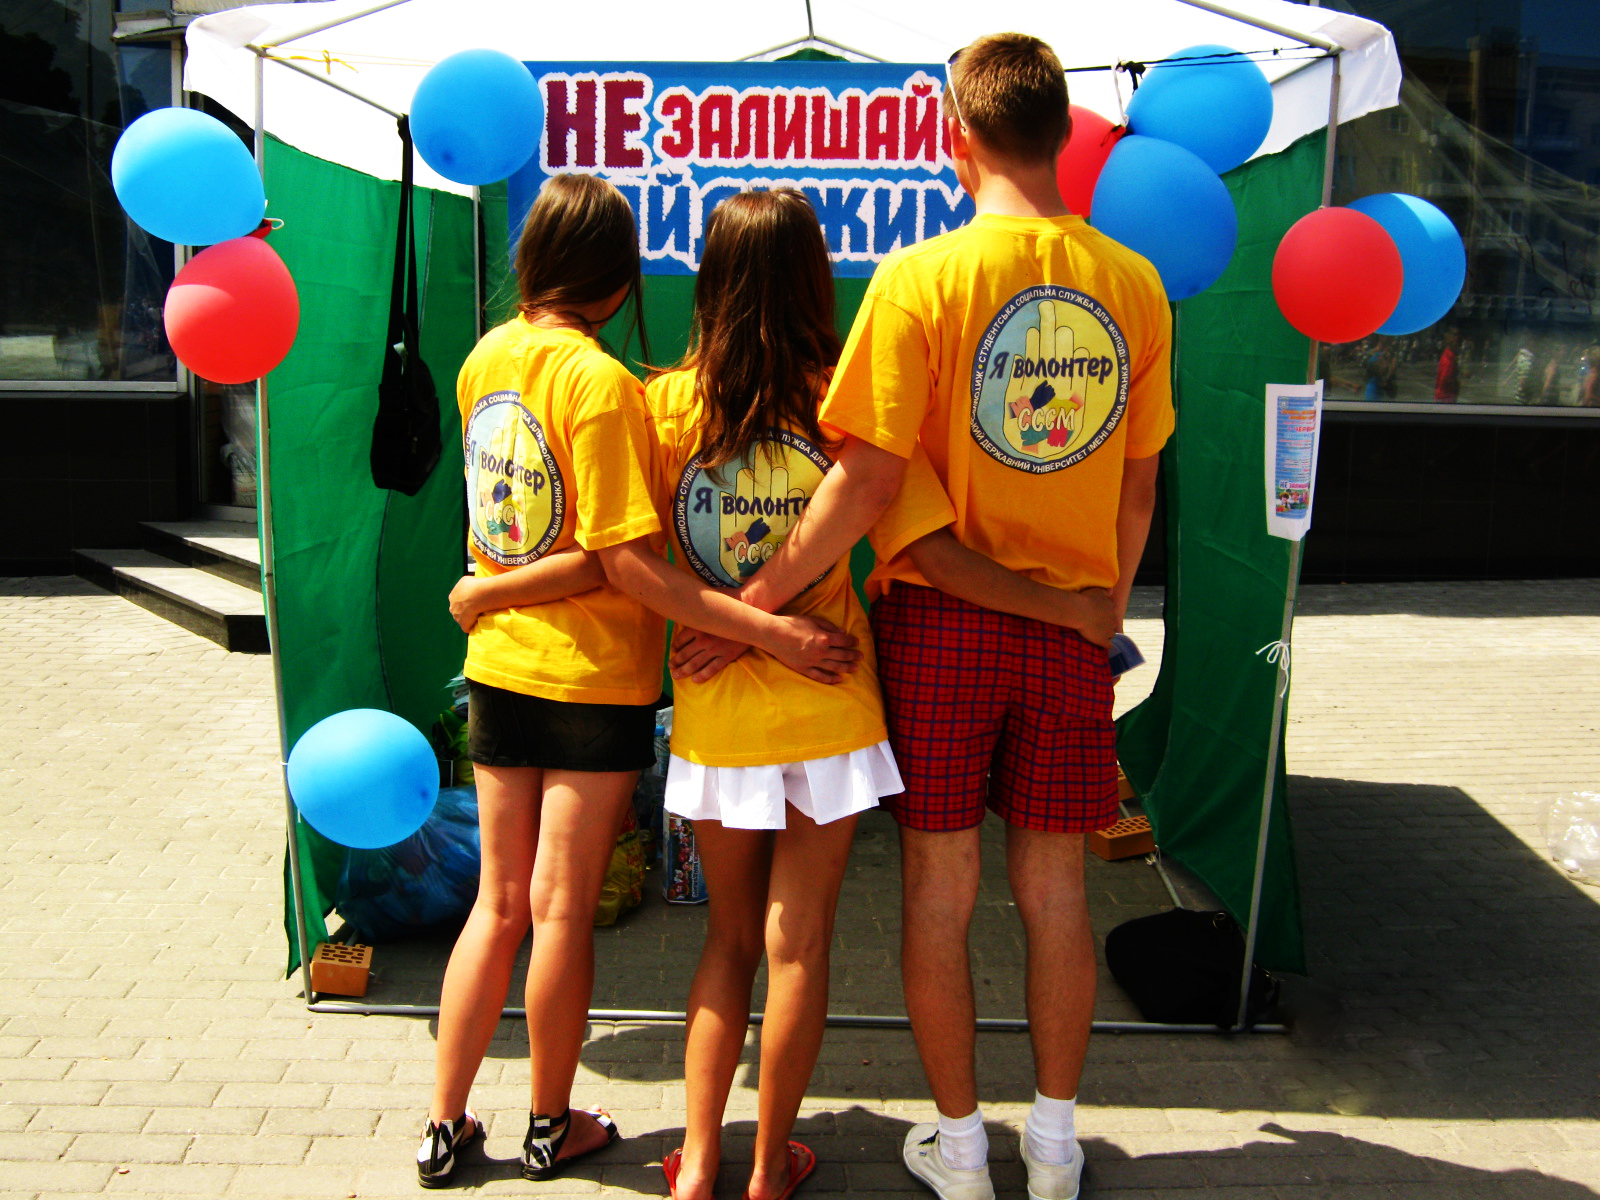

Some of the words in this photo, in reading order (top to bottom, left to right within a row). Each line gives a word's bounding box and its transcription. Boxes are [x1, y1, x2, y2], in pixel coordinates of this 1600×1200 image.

[546, 80, 644, 167] НЕ
[661, 79, 953, 162] ЗАЛИШАЙ
[978, 304, 1017, 363] СТУДЕНТСЬКА
[1058, 290, 1095, 311] СЛУЖБА
[1094, 307, 1110, 325] ДЛЯ
[1107, 324, 1126, 358] МОЛОДІ
[988, 352, 1010, 380] Я
[980, 439, 1031, 471] ДЕРЖАВНИЙ
[1032, 450, 1088, 474] УНІВЕРСИТЕТ
[1087, 429, 1108, 452] ІМЕНІ
[1107, 405, 1125, 432] ІВАНА
[1119, 363, 1129, 403] ФРАНКА
[1017, 407, 1076, 432] СССМ
[529, 422, 543, 441] ДЛЯ
[539, 440, 557, 474] МОЛОДІ
[810, 451, 829, 468] ДЛЯ
[554, 480, 563, 515] ФРАНКА
[693, 487, 714, 514] Я
[549, 516, 562, 538] ІВАНА
[676, 501, 704, 571] ЖИТОМИРСЬКИЙ
